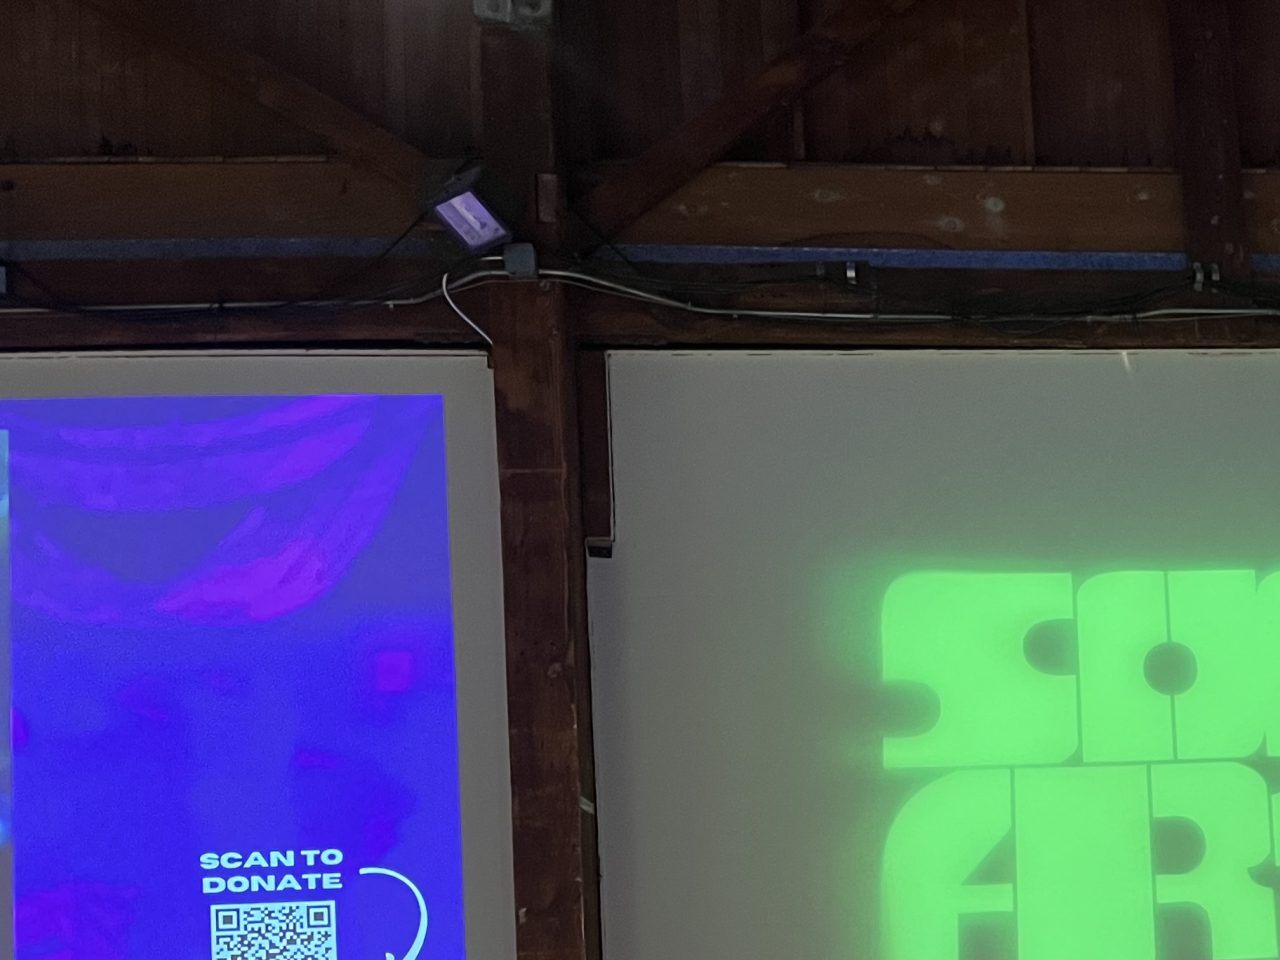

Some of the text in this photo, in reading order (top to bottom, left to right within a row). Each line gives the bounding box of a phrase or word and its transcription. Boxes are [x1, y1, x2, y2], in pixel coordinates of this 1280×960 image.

[200, 848, 344, 870] SCAN TO
[202, 872, 343, 894] DONATE
